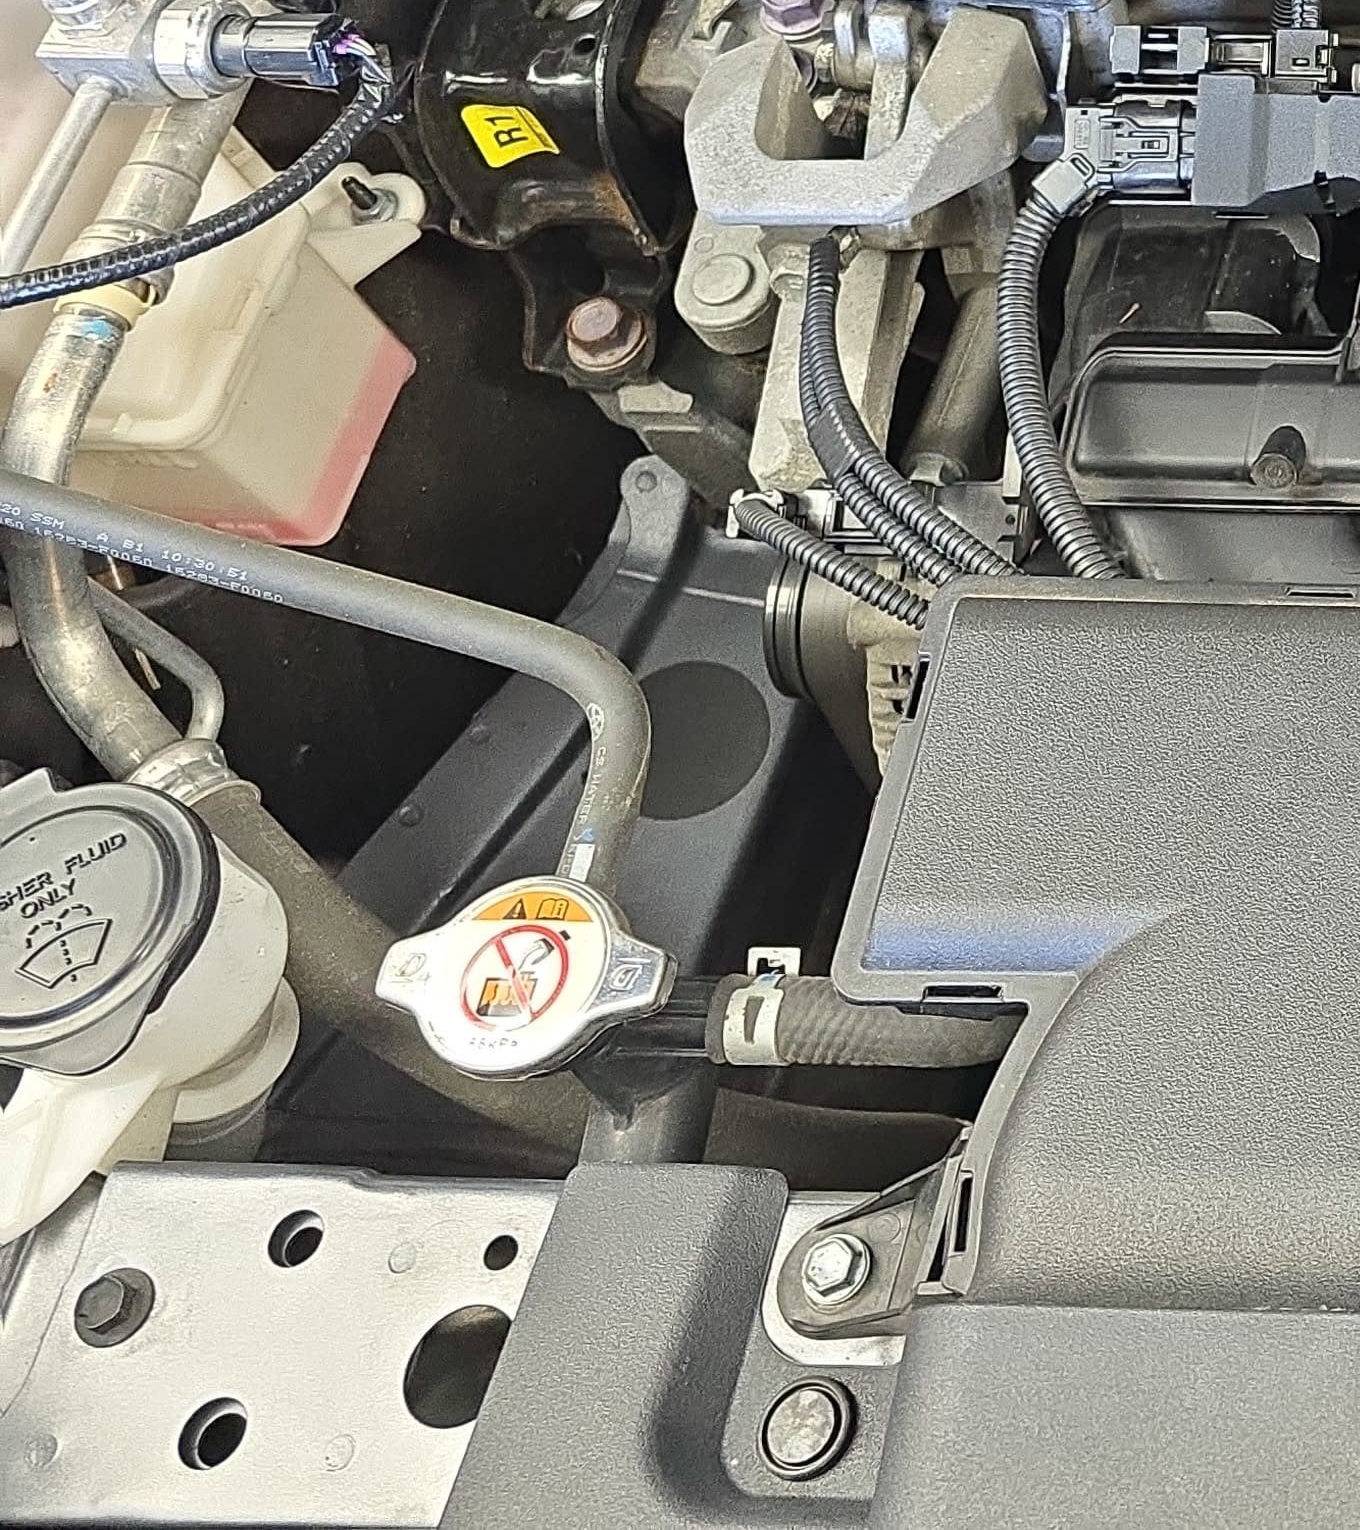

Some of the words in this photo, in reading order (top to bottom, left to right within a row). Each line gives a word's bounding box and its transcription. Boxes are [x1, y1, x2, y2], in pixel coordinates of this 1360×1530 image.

[484, 116, 529, 148] R1
[64, 833, 127, 874] FLUID
[21, 878, 76, 919] ONLY
